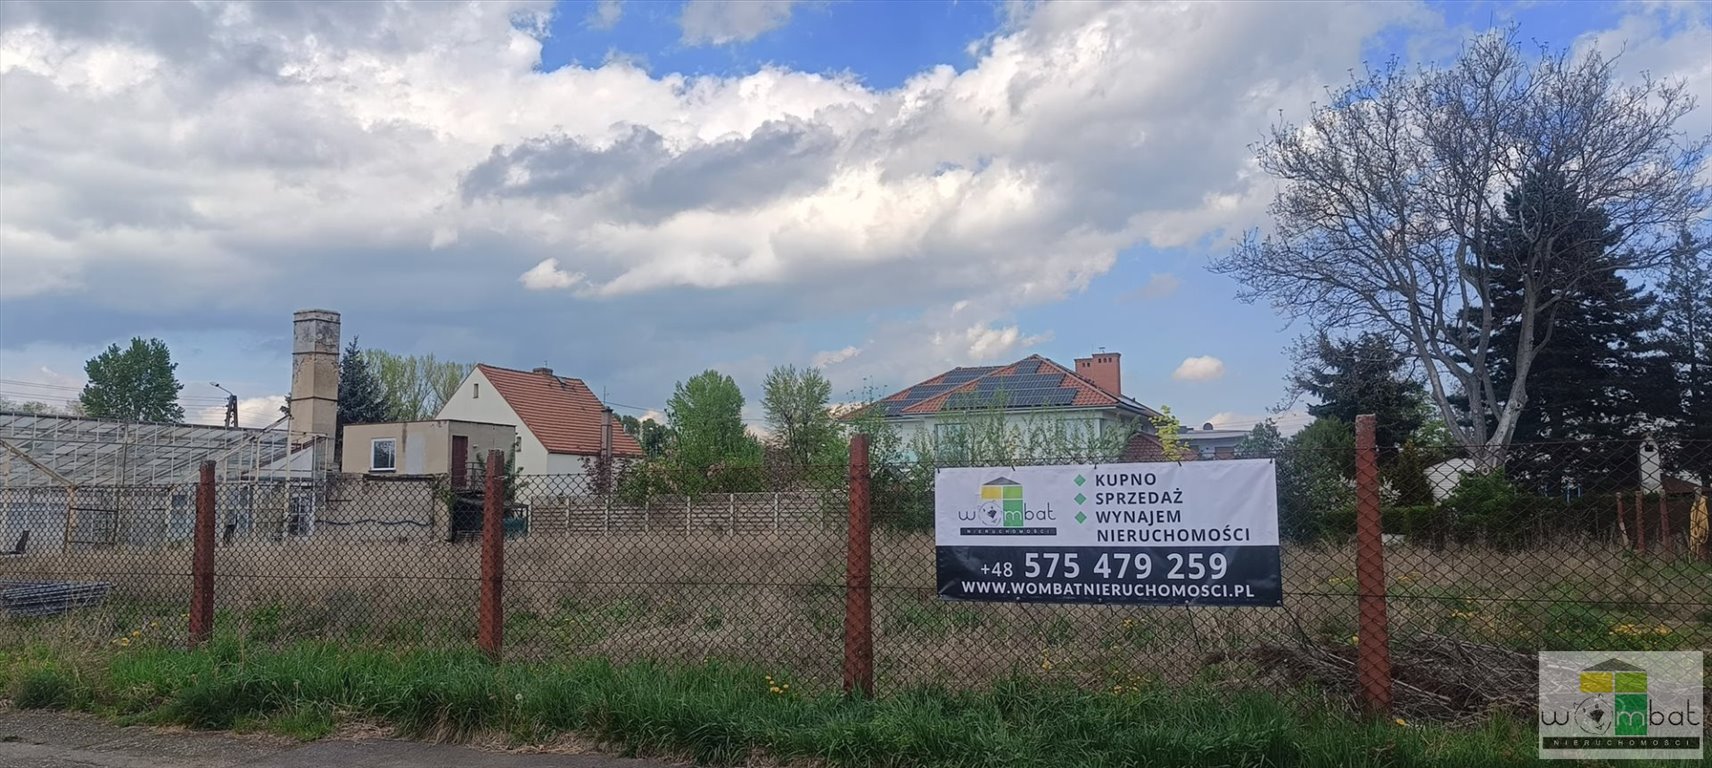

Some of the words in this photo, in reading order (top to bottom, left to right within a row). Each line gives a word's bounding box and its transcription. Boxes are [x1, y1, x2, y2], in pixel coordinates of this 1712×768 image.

[1095, 473, 1157, 487] KUPNO
[1095, 488, 1183, 505] SPRZEDAŻ
[1096, 510, 1182, 525] WYNAJEM
[1097, 525, 1251, 543] NIERUCHOMOŚCI
[980, 562, 1013, 578] +48
[1024, 553, 1081, 578] 575
[1093, 553, 1152, 579] 479
[1166, 553, 1228, 580] 259
[961, 580, 1255, 598] WWW.WOMBATNIERUCHOMOSCI.PL
